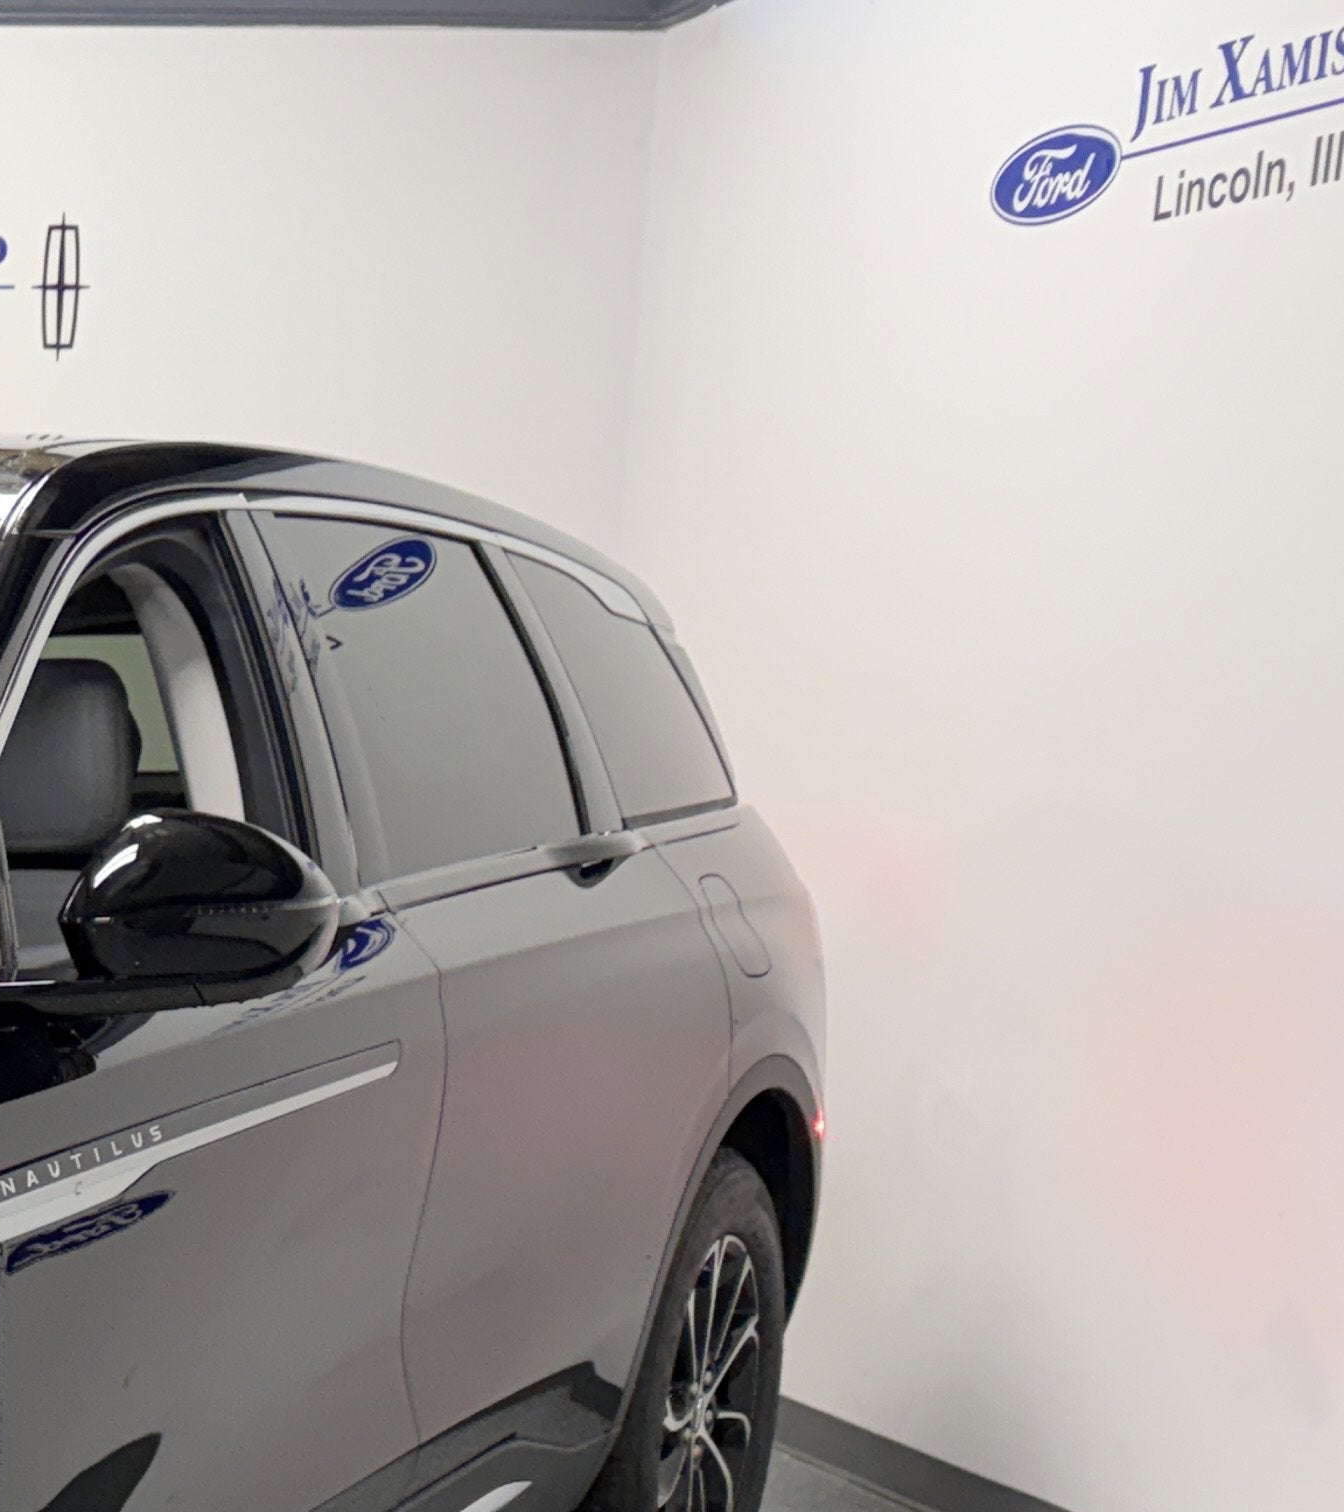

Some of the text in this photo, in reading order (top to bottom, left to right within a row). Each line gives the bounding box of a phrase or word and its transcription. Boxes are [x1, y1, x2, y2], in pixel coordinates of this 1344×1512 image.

[1130, 63, 1203, 143] JIM
[1013, 143, 1097, 214] Ford
[1152, 149, 1296, 222] Lincoln,
[0, 1124, 163, 1197] NAUTILUS
